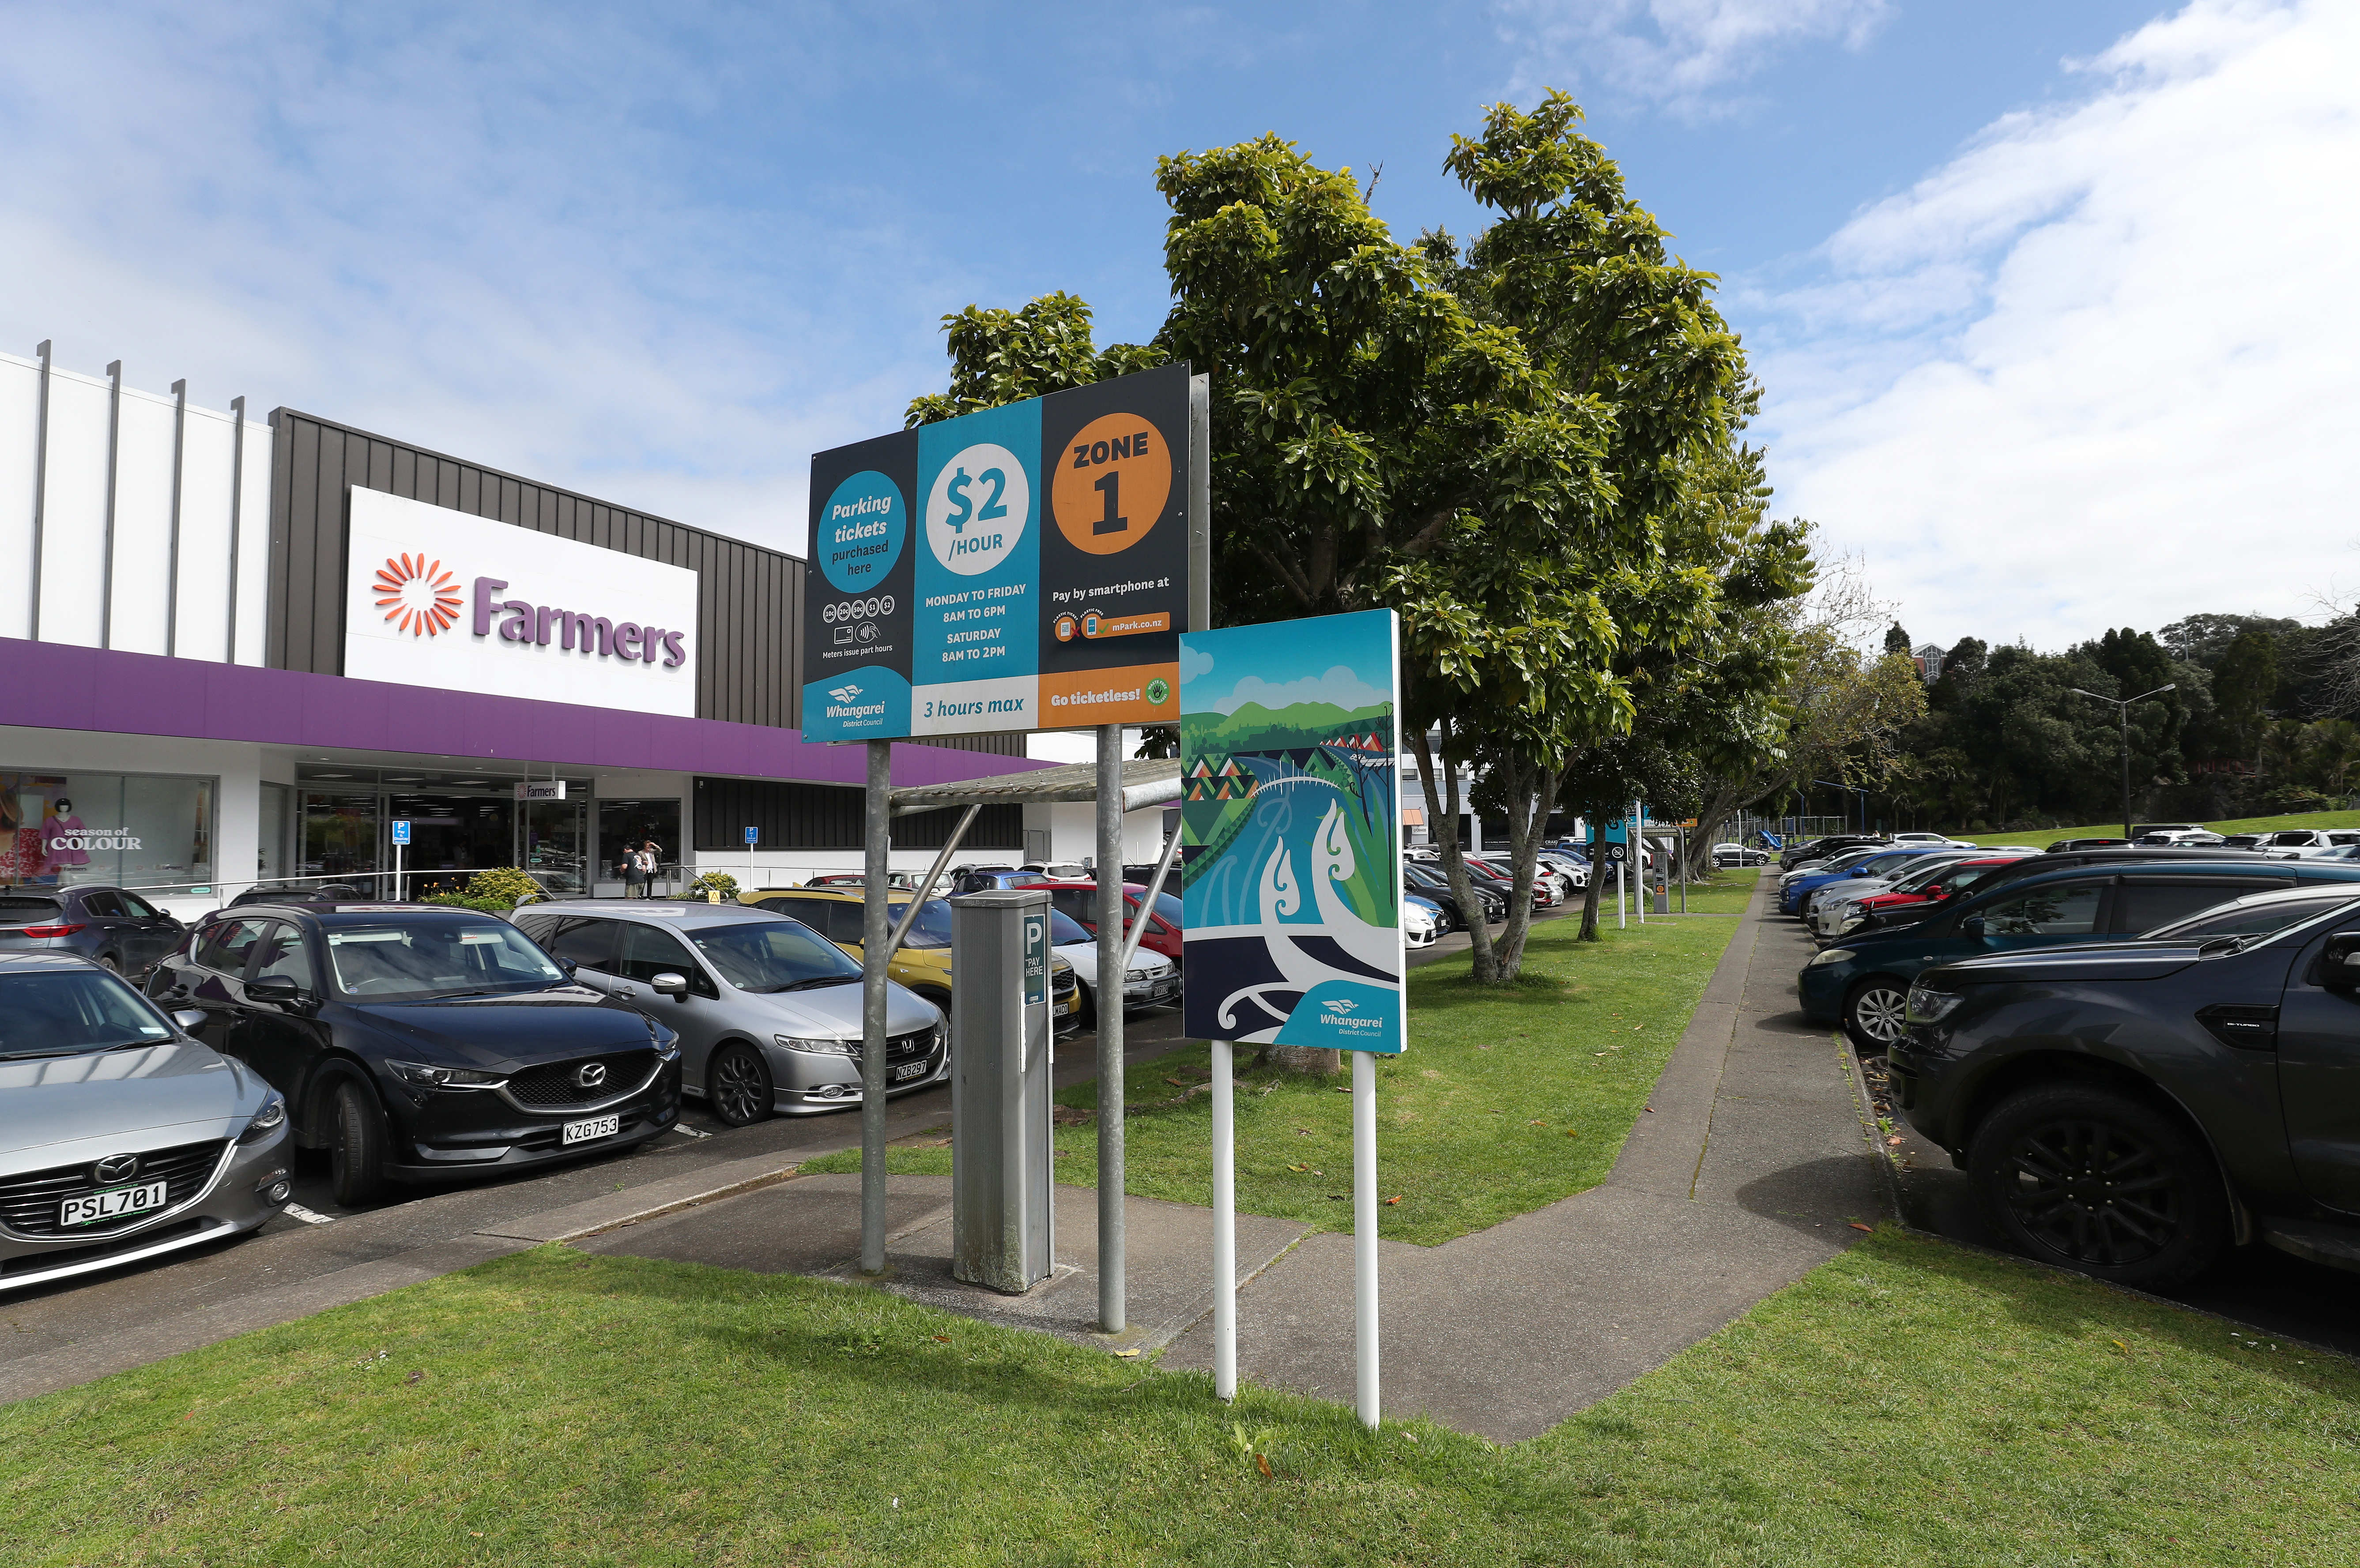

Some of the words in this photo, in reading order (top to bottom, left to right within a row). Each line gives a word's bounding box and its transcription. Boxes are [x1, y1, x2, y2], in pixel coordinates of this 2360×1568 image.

[1074, 431, 1148, 469] ZONE
[832, 495, 891, 520] Parking
[945, 467, 1007, 534] $2
[1093, 471, 1127, 536] 1
[835, 521, 887, 543] tickets
[832, 539, 889, 565] purchased
[948, 534, 1003, 562] /HOUR
[847, 563, 871, 576] here
[926, 592, 969, 607] MONDAY
[972, 590, 985, 601] TO
[988, 584, 1026, 599] FRIDAY
[1052, 592, 1071, 603] Pay
[1073, 588, 1086, 601] by
[1088, 580, 1154, 596] smartphone
[1157, 577, 1170, 588] at
[474, 576, 686, 667] Farmers
[943, 611, 965, 623] 8AM
[968, 608, 981, 619] TO
[984, 605, 1006, 618] 6PM
[1053, 611, 1066, 623] PLASTIC
[1067, 611, 1078, 621] TICKET
[1080, 608, 1095, 618] PLASTIC
[1112, 619, 1162, 631] mPark.co.nz
[947, 628, 1001, 644] SATURDAY
[822, 650, 842, 659] Meters
[860, 646, 874, 657] part
[942, 650, 964, 662] 8AM
[967, 648, 980, 660] TO
[983, 646, 1005, 658] 2PM
[1148, 680, 1159, 690] WASTE
[1159, 681, 1168, 690] FREE
[1051, 694, 1068, 706] Go
[1070, 688, 1140, 705] ticketless!
[1148, 694, 1168, 704] WHANGAREI
[826, 701, 885, 718] Whangarei
[924, 701, 933, 718] 3
[938, 700, 983, 717] hours
[988, 698, 1024, 713] max
[527, 785, 555, 797] Farmers
[114, 827, 129, 836] of
[51, 837, 143, 850] COLOUR
[1027, 922, 1042, 955] P
[1028, 957, 1040, 967] PAY
[1026, 965, 1043, 977] HERE
[1320, 1014, 1383, 1029] Whangarei
[897, 1062, 926, 1079] NZB297
[566, 1118, 617, 1142] KZG753
